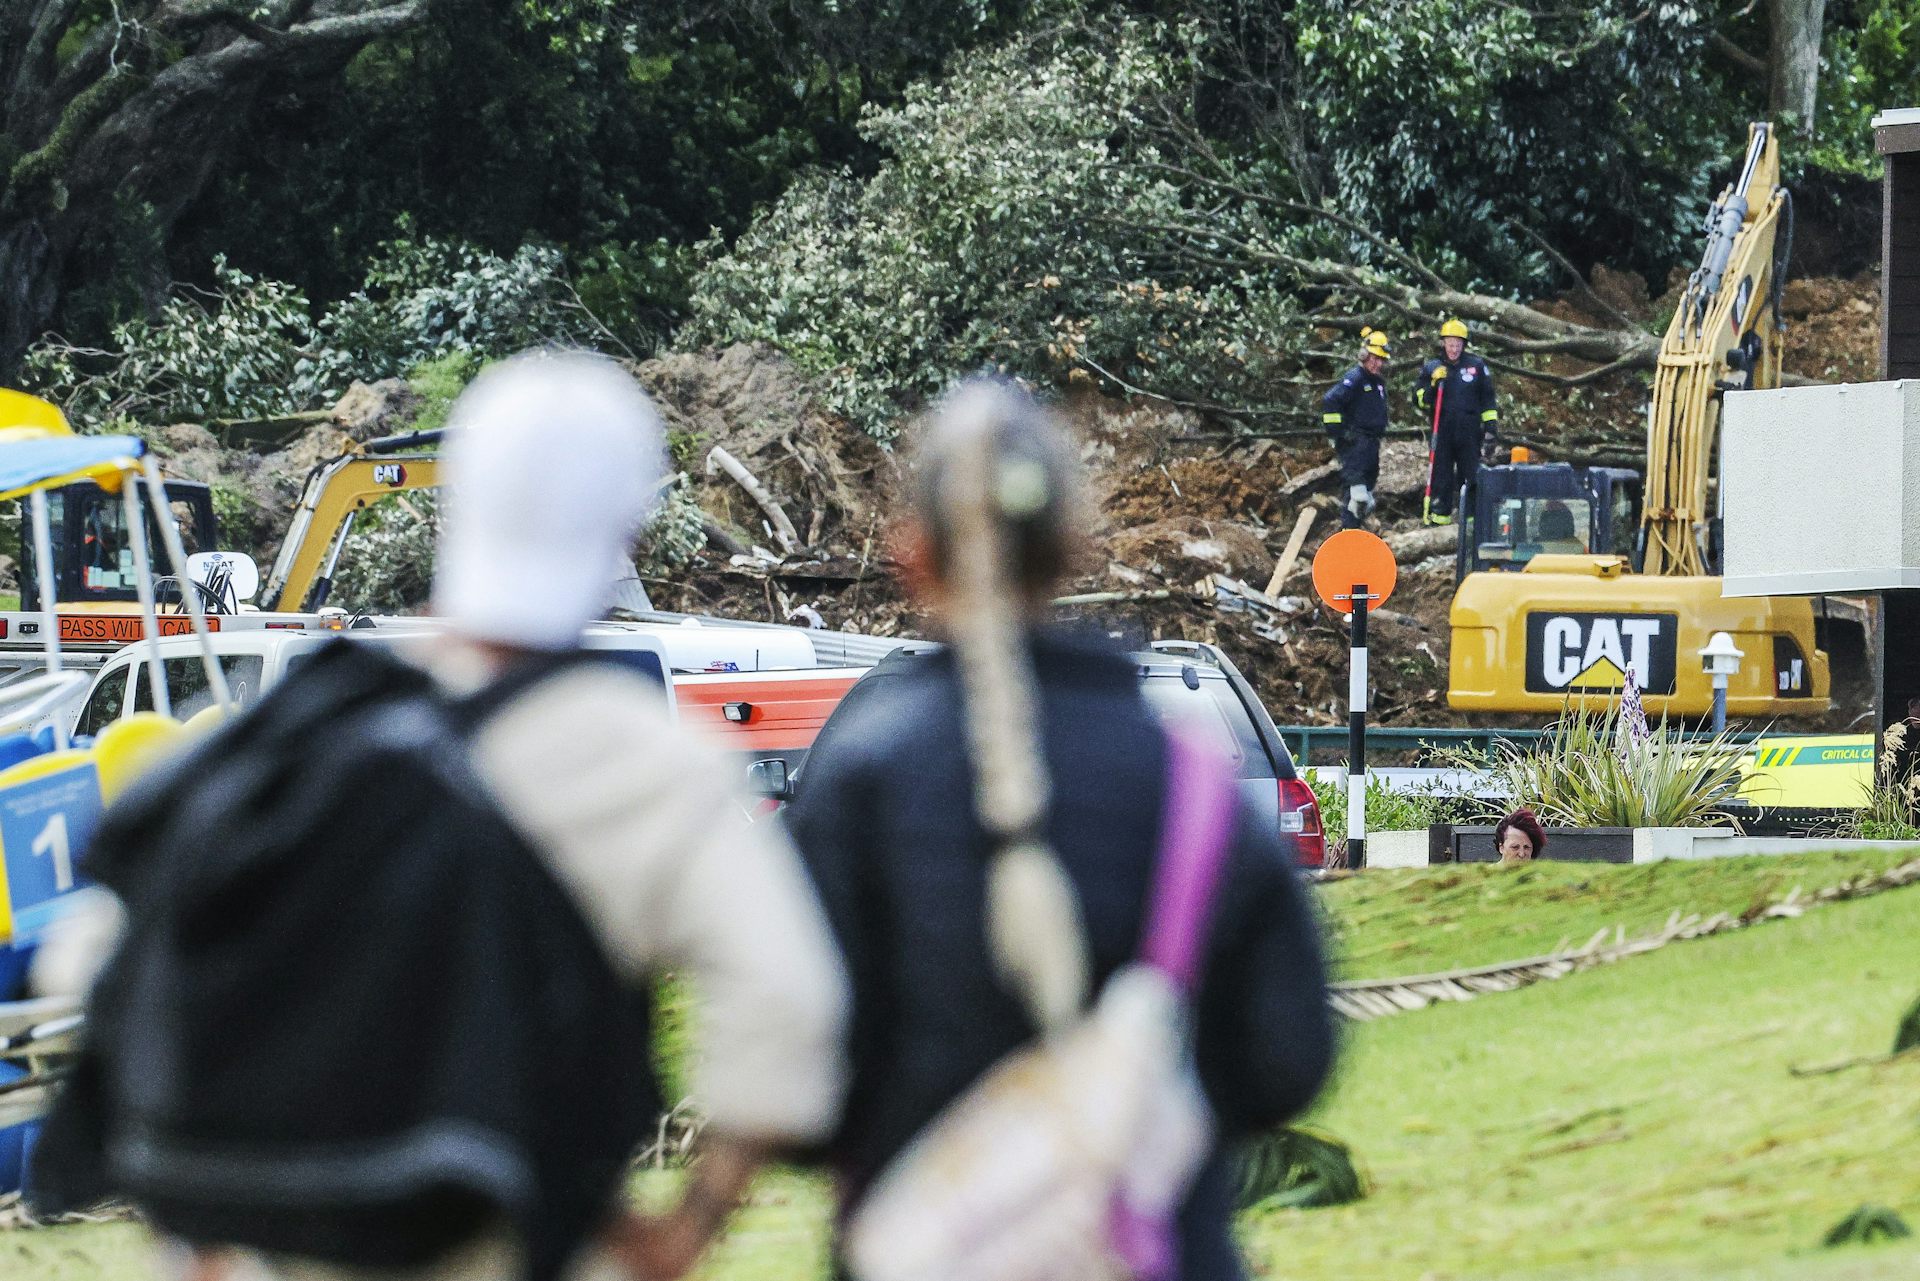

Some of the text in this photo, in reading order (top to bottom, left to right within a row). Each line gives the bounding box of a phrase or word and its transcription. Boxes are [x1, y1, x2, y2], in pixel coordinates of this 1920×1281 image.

[374, 464, 400, 484] CAT
[60, 619, 212, 638] PASS WIT CA
[1542, 616, 1660, 689] CAT
[1821, 749, 1859, 761] CRITICAL
[31, 812, 74, 892] 1
